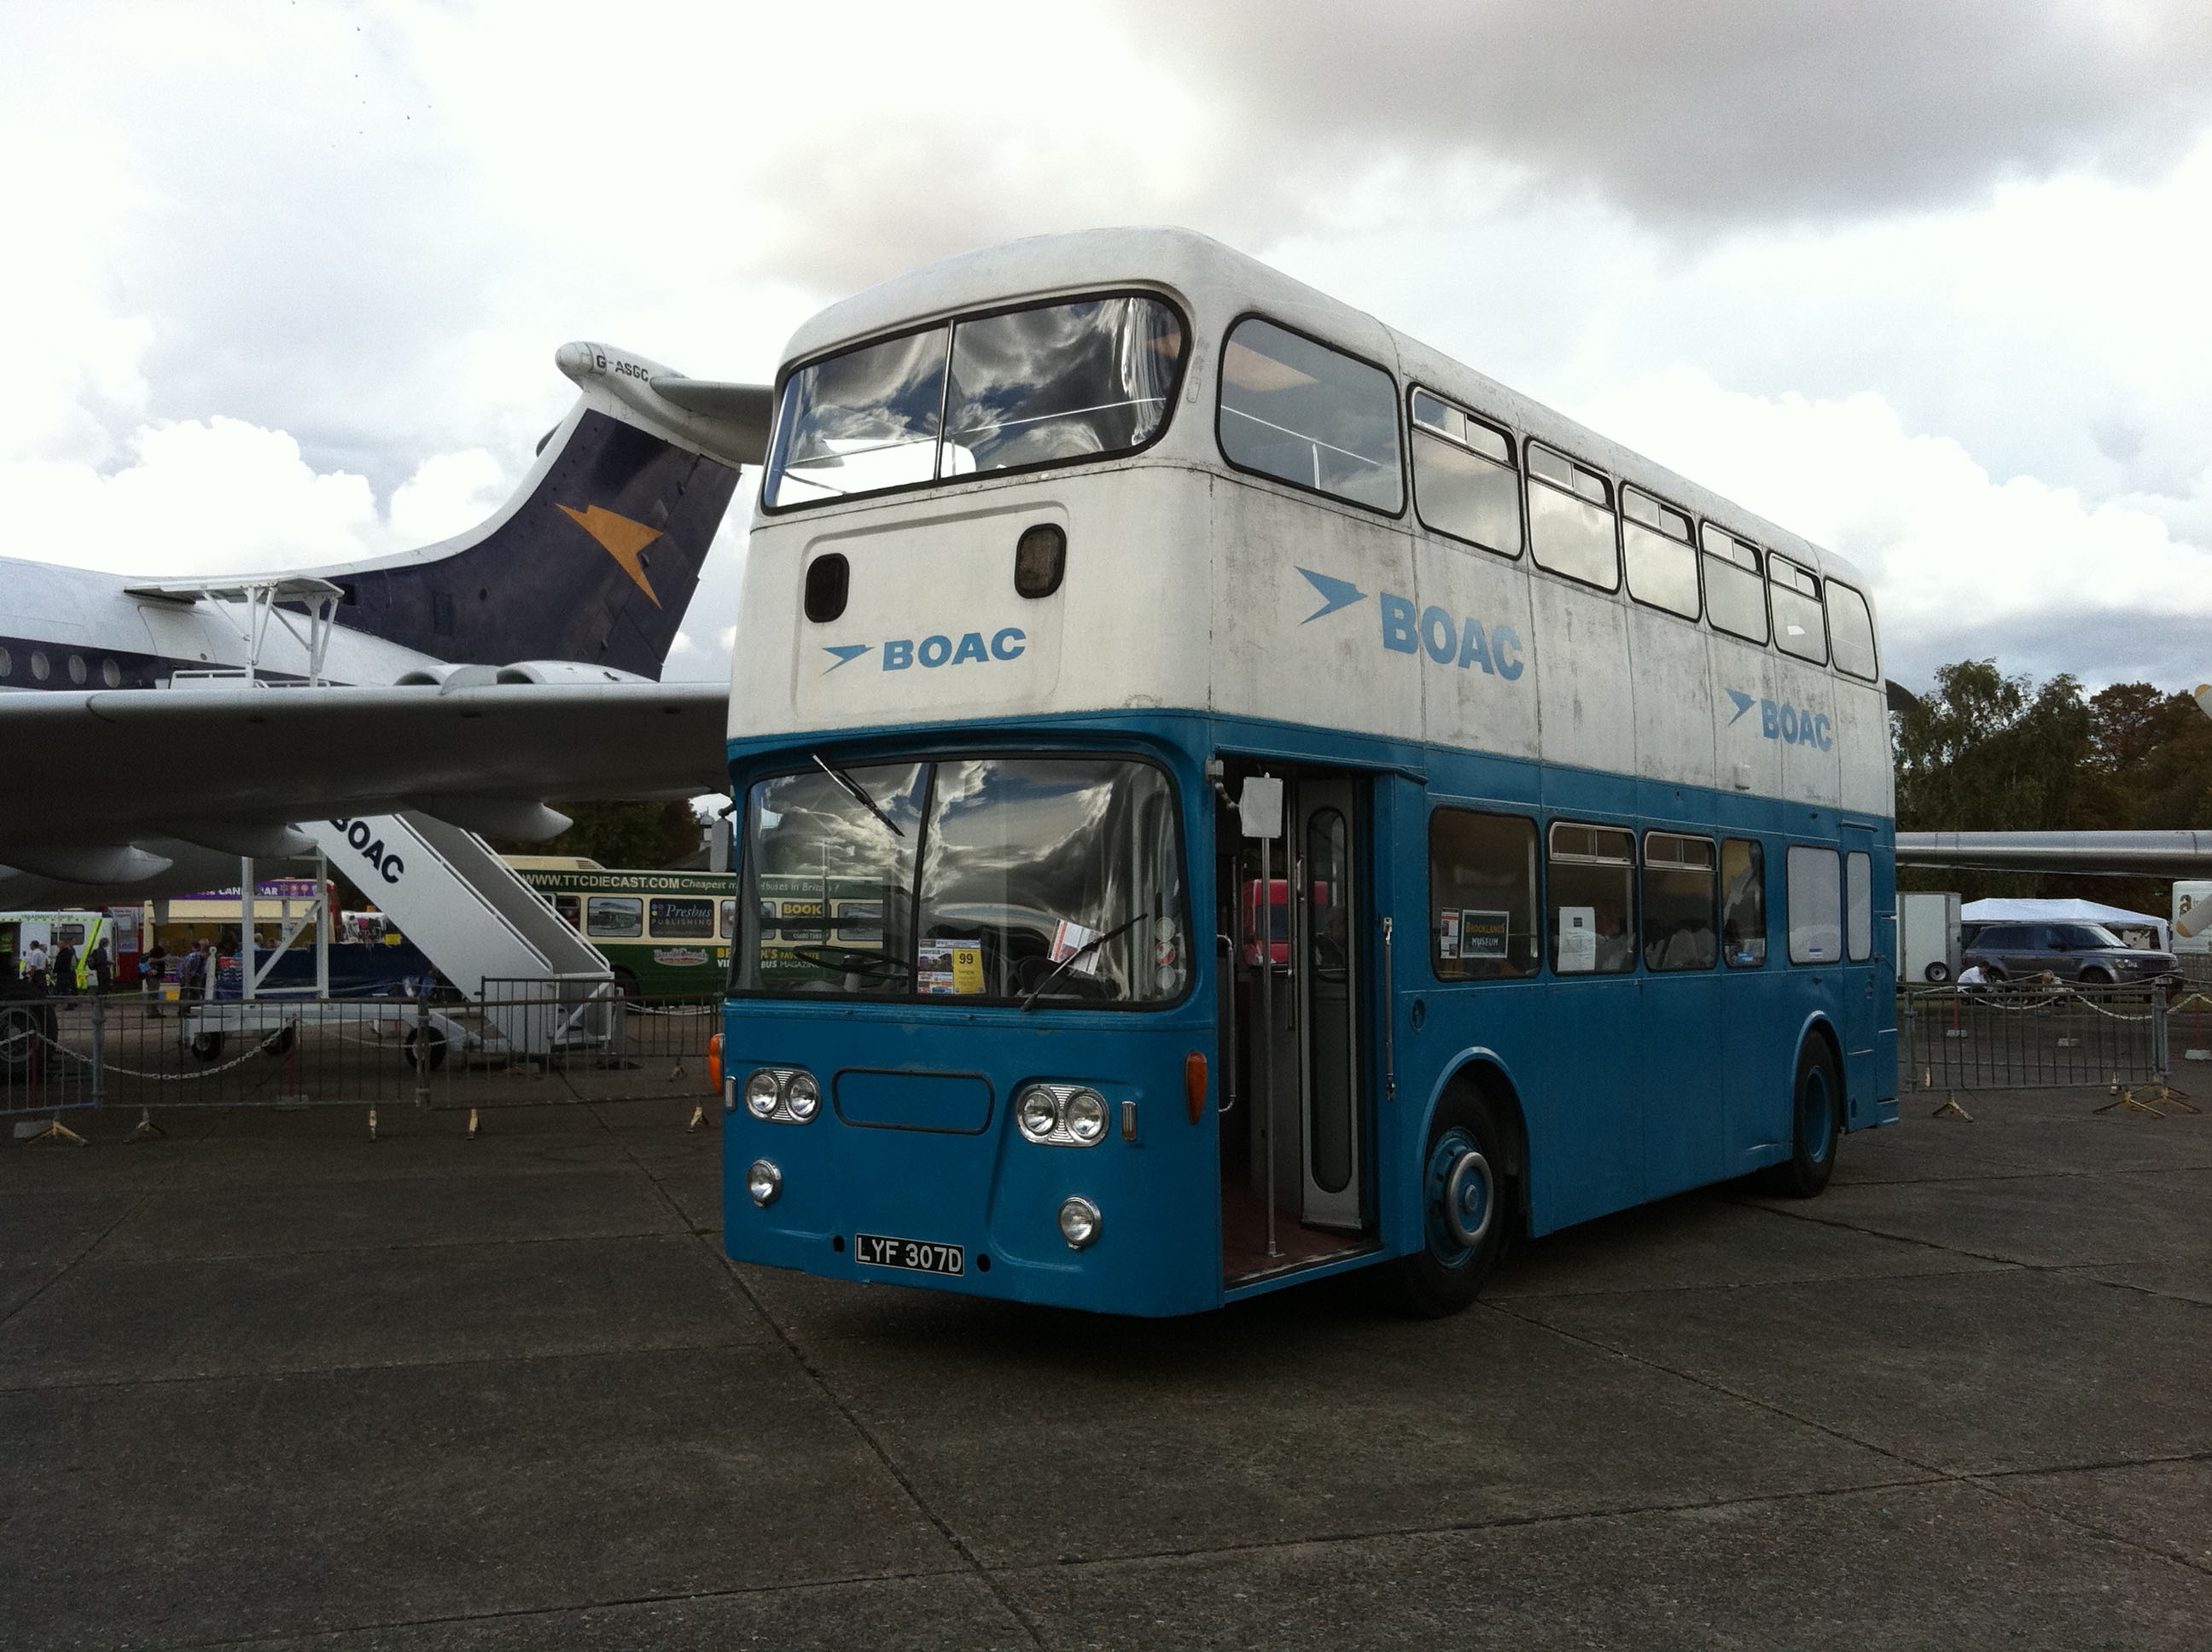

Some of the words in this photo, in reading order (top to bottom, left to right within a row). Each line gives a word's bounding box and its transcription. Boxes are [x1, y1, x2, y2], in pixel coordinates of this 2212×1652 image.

[597, 355, 649, 382] G-ASGC
[1379, 591, 1523, 681] BOAC
[882, 627, 1027, 672] BOAC
[1761, 698, 1831, 752] BOAC
[523, 874, 679, 889] WWW.TTCDIECAST.COM
[783, 904, 823, 914] BOOK
[650, 917, 712, 926] PUBLISHING
[760, 959, 778, 969] BUS
[959, 953, 974, 964] 99
[857, 1236, 899, 1264] LYF
[905, 1242, 963, 1272] 307D
